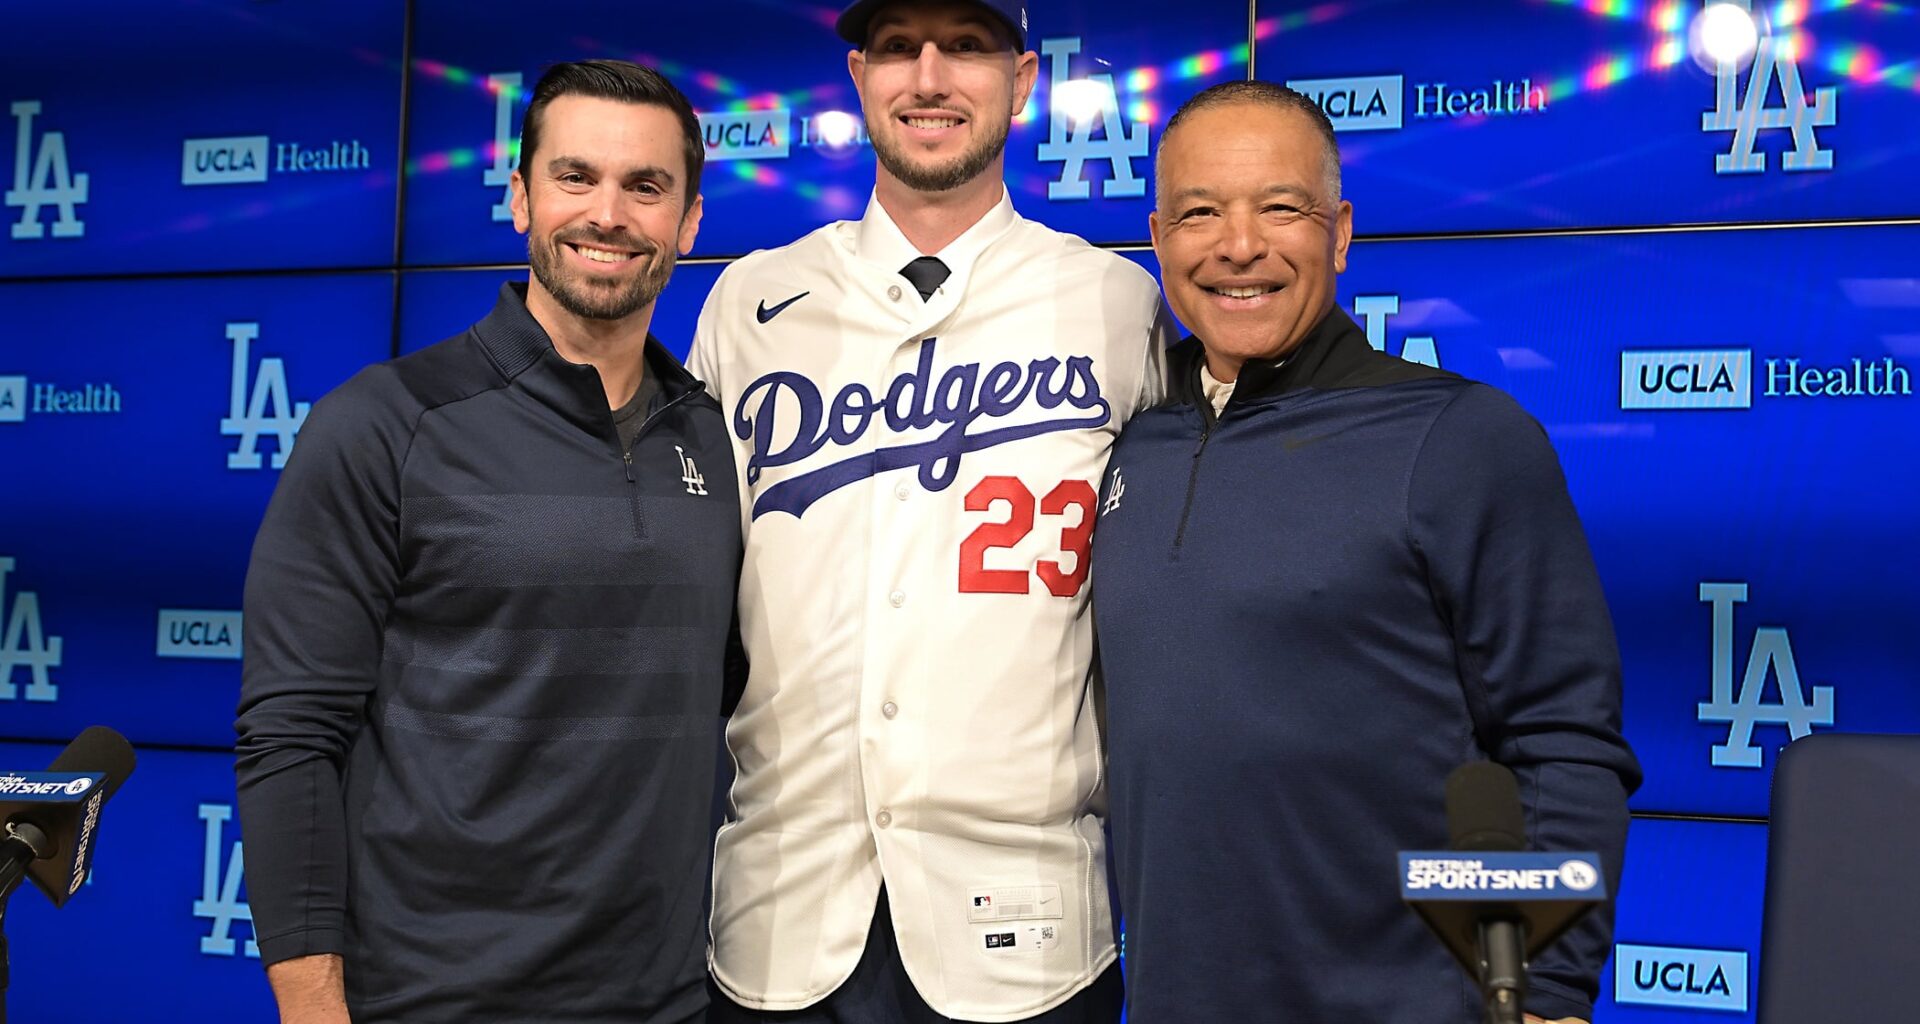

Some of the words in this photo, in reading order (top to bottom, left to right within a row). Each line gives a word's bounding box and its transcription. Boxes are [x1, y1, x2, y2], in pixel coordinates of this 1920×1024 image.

[1037, 36, 1149, 200] LA
[1414, 79, 1547, 118] Health
[705, 121, 777, 149] UCLA
[5, 100, 89, 238] LA
[195, 148, 256, 173] UCLA
[276, 140, 370, 173] Health
[220, 322, 311, 469] LA
[1639, 361, 1735, 394] UCLA
[1763, 356, 1913, 397] Health
[32, 382, 121, 413] Health
[733, 337, 1111, 498] Dodgers
[674, 445, 709, 496] LA
[1102, 466, 1126, 517] LA
[958, 475, 1098, 598] 23
[170, 621, 232, 647] UCLA
[1698, 582, 1834, 768] LA
[0, 782, 68, 795] RTSNET
[1405, 868, 1559, 891] SPORTSNET
[1633, 959, 1731, 997] UCLA
